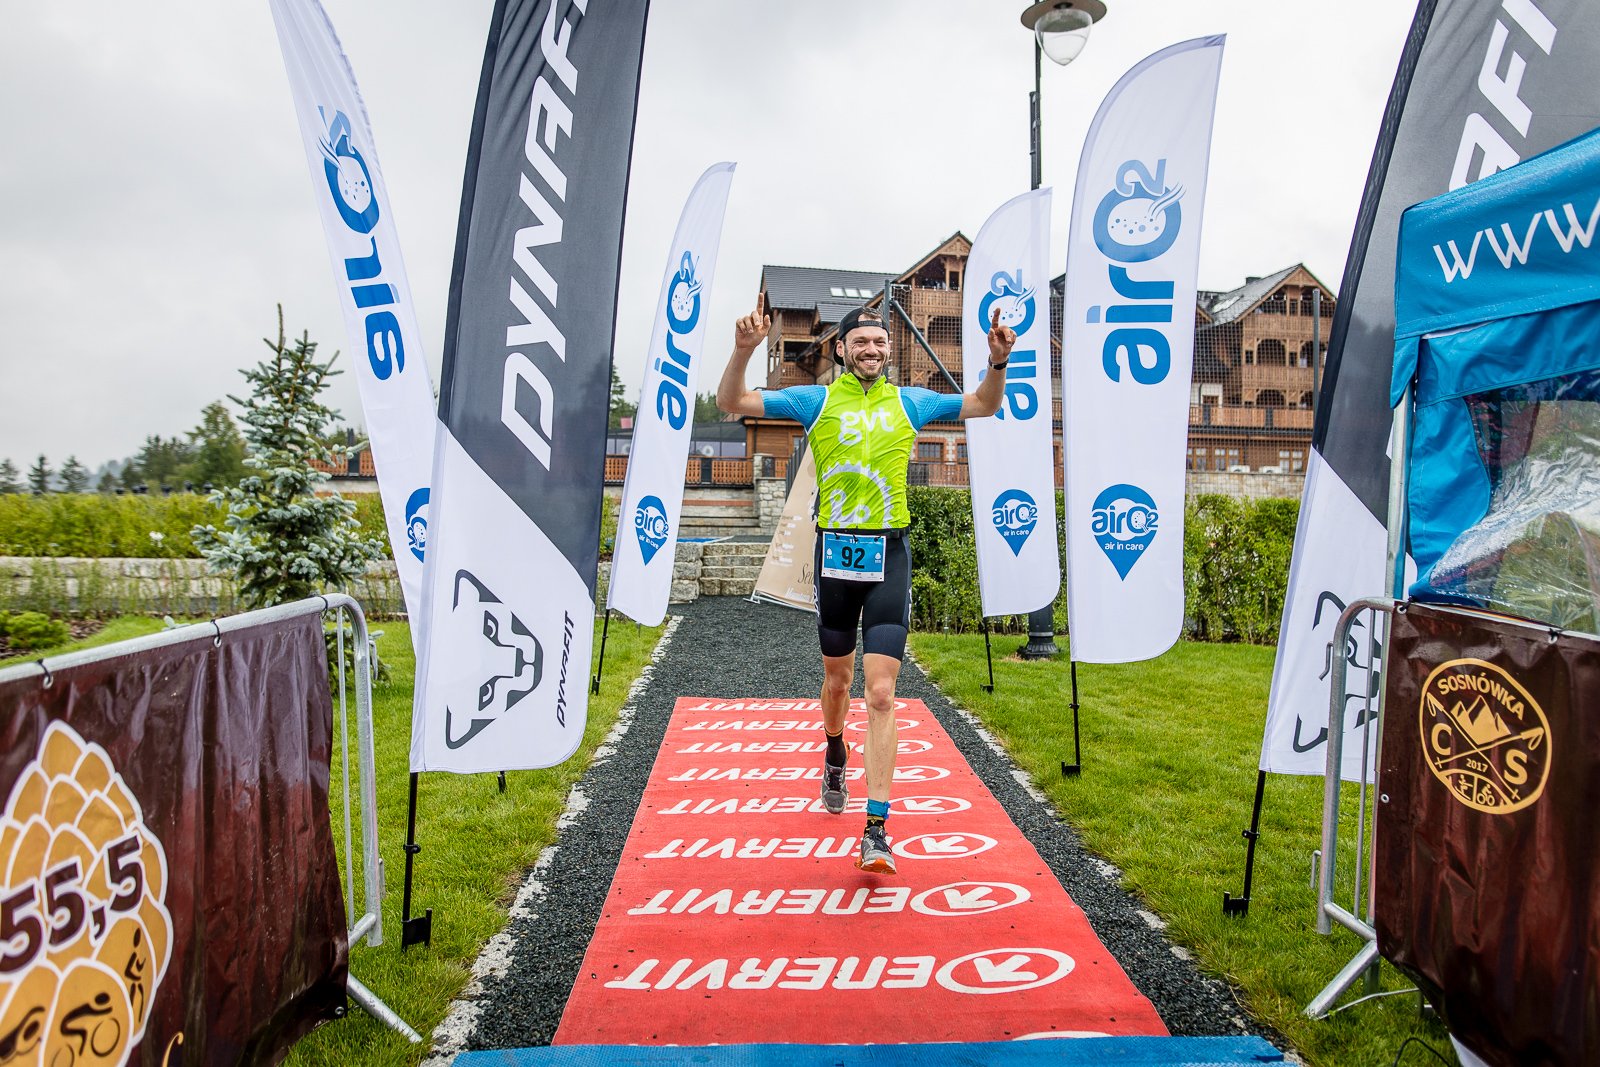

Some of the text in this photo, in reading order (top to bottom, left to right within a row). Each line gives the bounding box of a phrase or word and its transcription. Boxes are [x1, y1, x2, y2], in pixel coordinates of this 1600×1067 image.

[838, 407, 895, 446] gvt
[841, 546, 866, 569] 92
[1104, 542, 1145, 551] air in care
[557, 610, 574, 728] DYNAFIT
[688, 701, 823, 711] NERVIT
[1437, 672, 1525, 721] SOSNÓWKA
[683, 720, 846, 732] NERVIT
[1431, 723, 1452, 756] C
[1465, 758, 1489, 773] 2017
[1503, 749, 1528, 785] S
[0, 835, 143, 974] 55,5
